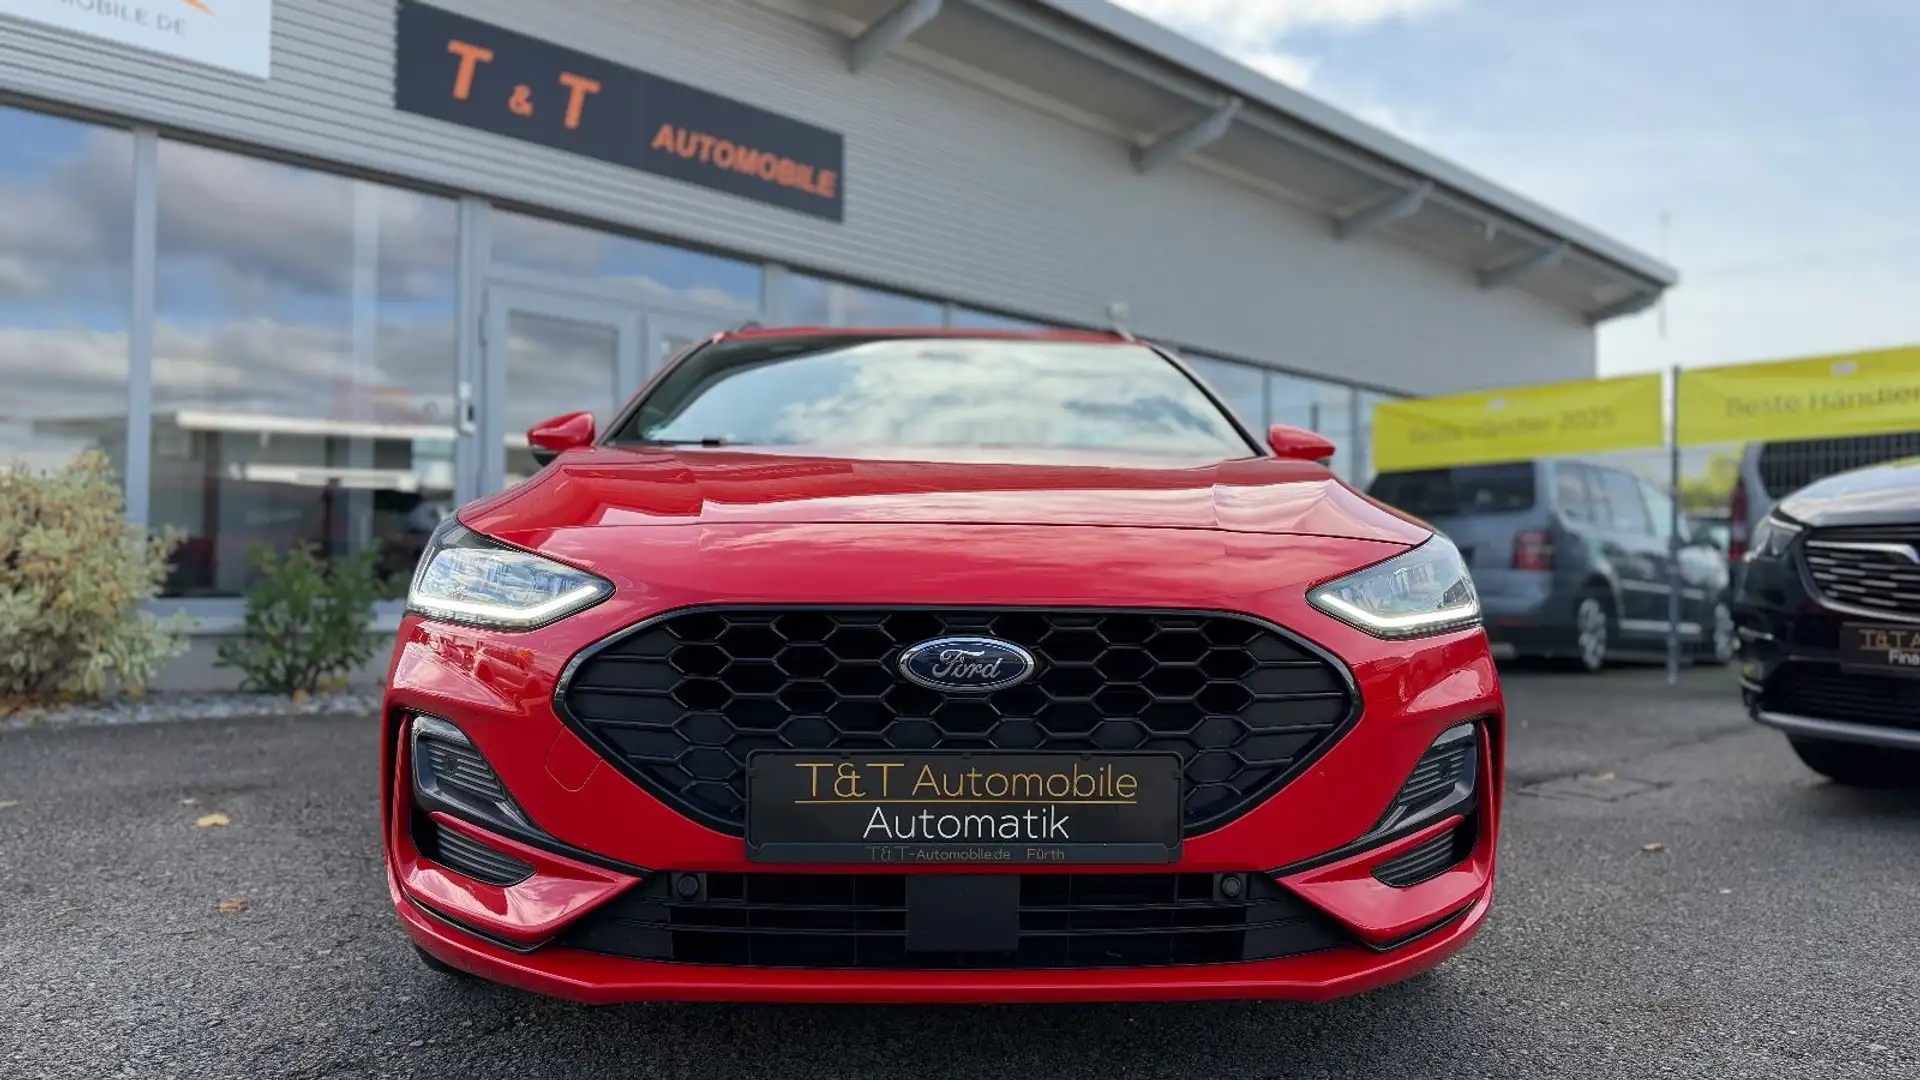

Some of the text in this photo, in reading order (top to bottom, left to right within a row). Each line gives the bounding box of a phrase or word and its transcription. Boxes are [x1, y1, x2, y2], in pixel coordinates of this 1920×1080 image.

[448, 39, 838, 198] T & T AUTOMOBILE
[931, 648, 1003, 679] Ford
[795, 762, 1138, 798] T&T Automobile
[862, 805, 1070, 840] Automatik
[1026, 847, 1065, 861] Fürth
